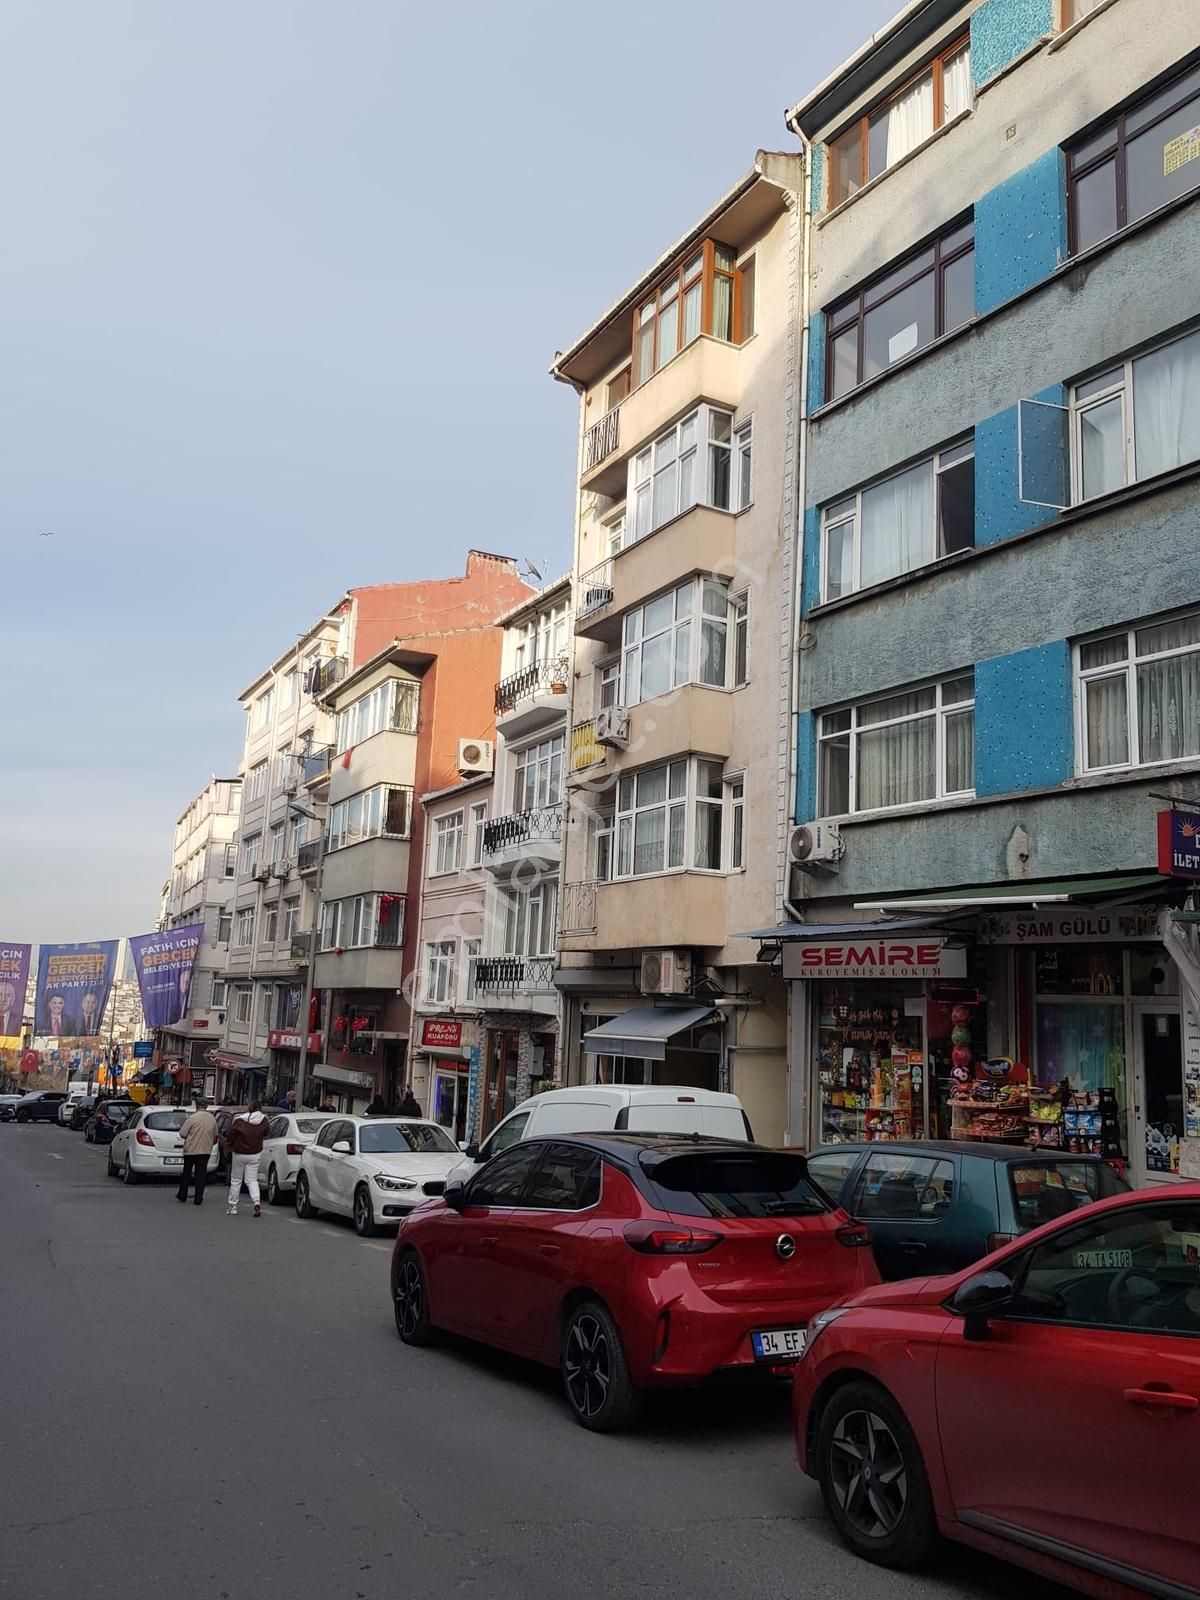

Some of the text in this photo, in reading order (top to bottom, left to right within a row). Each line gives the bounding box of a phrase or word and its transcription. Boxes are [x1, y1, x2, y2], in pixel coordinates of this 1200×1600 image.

[1016, 922, 1053, 941] ŞAM
[1059, 916, 1111, 936] GÜLÜ
[801, 941, 940, 967] SEMİRE
[801, 967, 942, 977] KURUYEMİŞ & LOKUM
[46, 982, 60, 990] AK
[762, 1333, 779, 1352] 34
